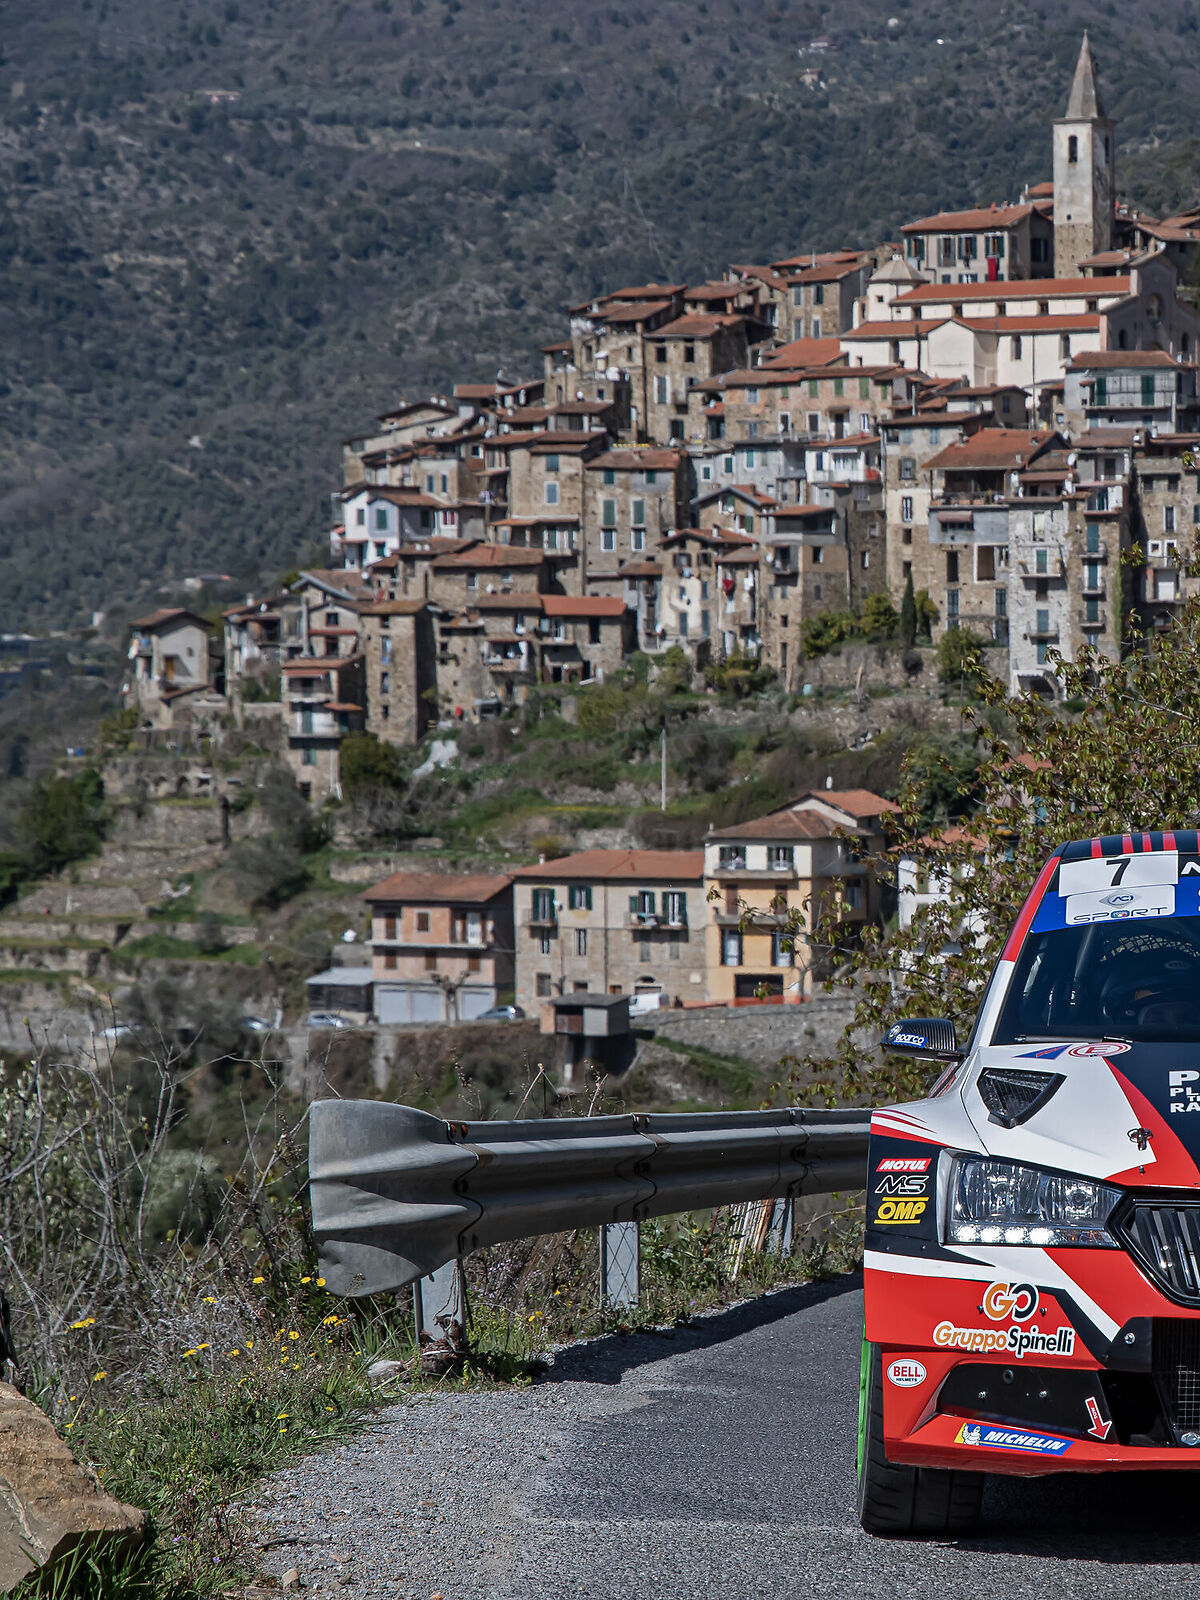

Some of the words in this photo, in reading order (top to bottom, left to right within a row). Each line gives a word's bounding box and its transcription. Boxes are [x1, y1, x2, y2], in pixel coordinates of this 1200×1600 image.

[1106, 858, 1131, 887] 7
[1073, 906, 1168, 923] SPORT
[878, 1159, 928, 1171] MOTUL
[876, 1201, 927, 1221] OMP
[893, 1366, 922, 1377] BELL
[984, 1430, 1066, 1450] MICHELIN
